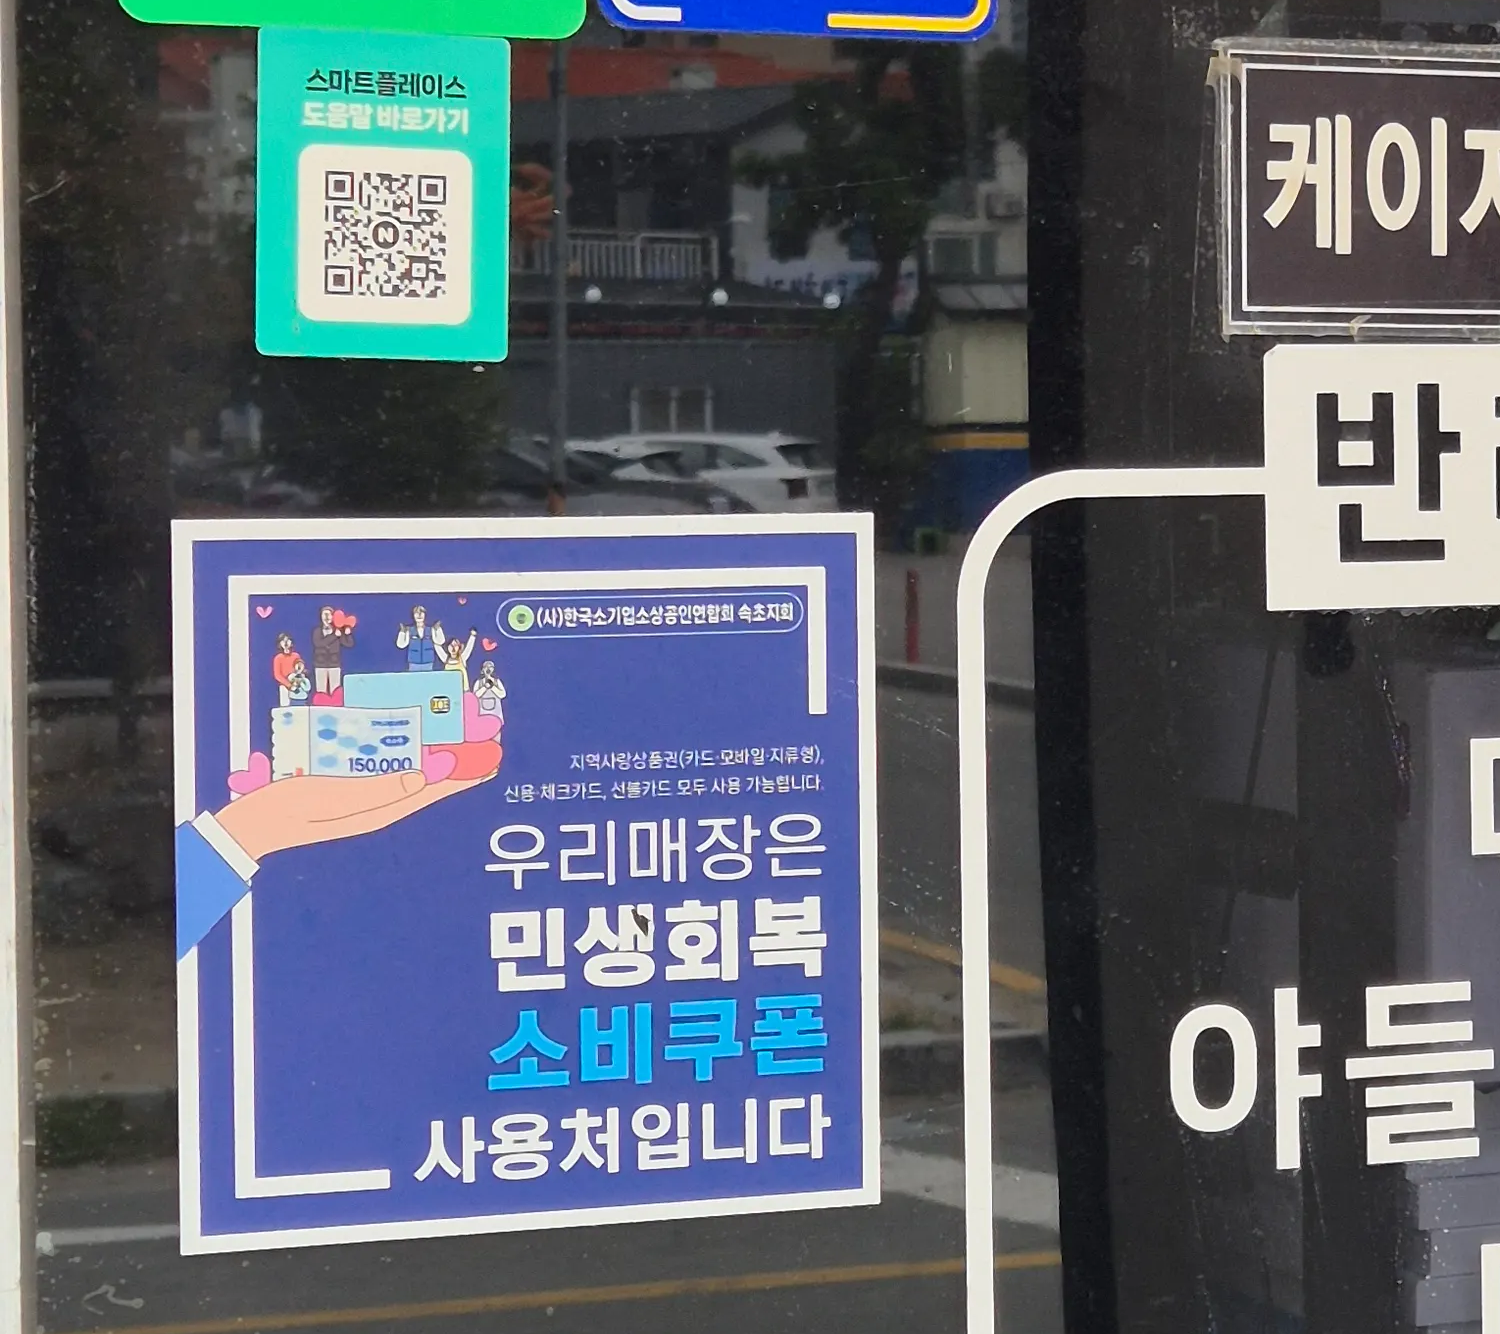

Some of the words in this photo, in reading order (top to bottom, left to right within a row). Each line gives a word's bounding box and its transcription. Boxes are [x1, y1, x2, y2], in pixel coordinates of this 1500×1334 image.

[306, 68, 467, 99] 스마트플레이스
[302, 101, 373, 131] 도움말
[376, 105, 469, 135] 바로가기
[737, 602, 794, 624] 속초지회
[677, 778, 709, 796] 모두
[711, 776, 741, 795] 사용
[485, 813, 827, 892] 우리매장은
[489, 896, 828, 993] 민생회복
[488, 994, 829, 1092] 소비쿠폰
[414, 1094, 831, 1183] 사용처입니다
